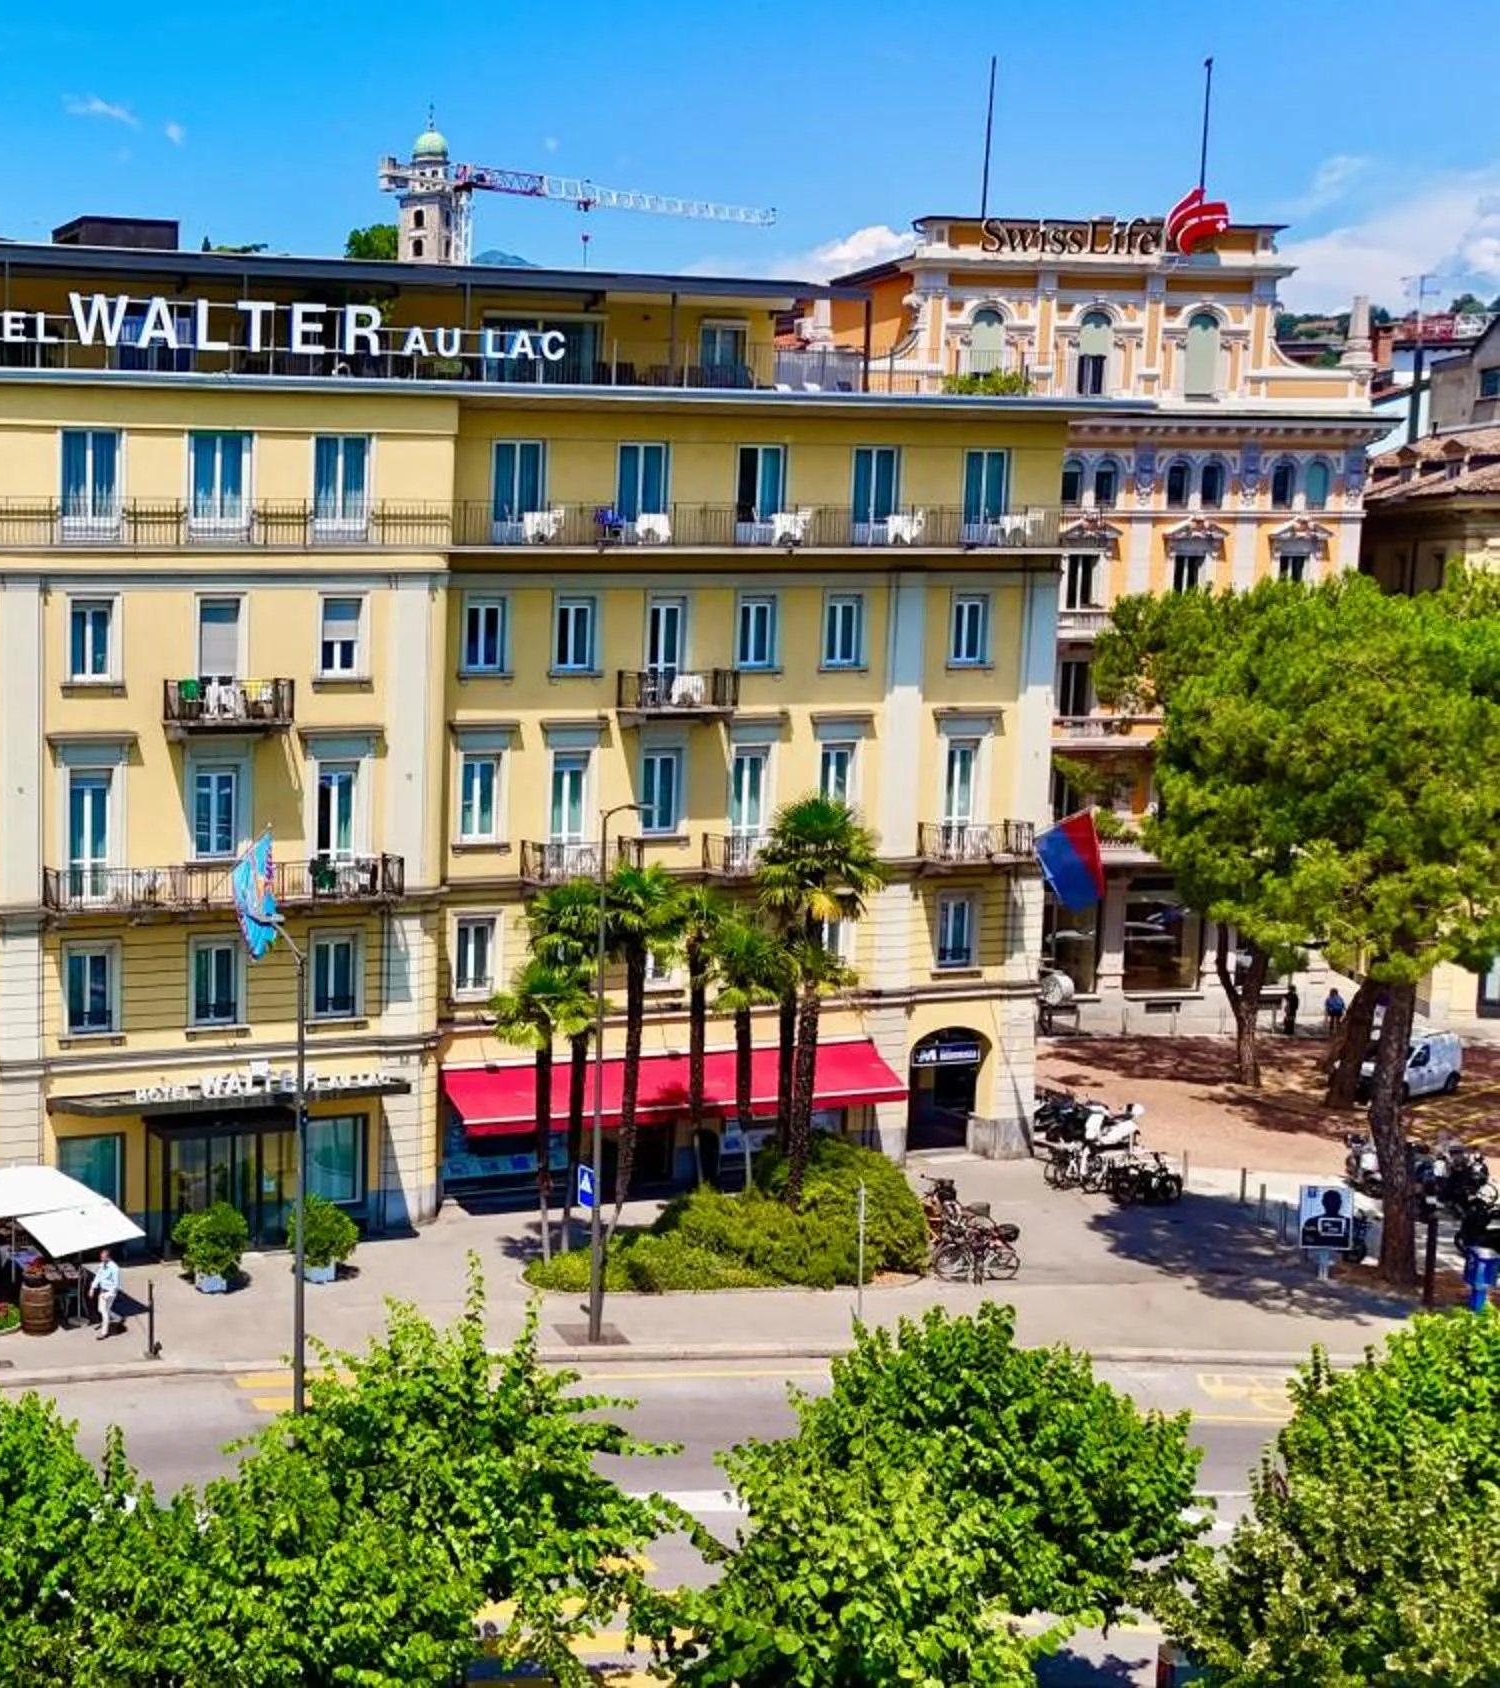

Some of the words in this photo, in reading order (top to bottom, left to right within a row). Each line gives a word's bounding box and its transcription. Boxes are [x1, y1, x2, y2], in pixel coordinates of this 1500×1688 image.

[68, 291, 382, 356] WALTER
[402, 326, 461, 357] AU
[479, 328, 566, 361] LAC
[134, 1087, 192, 1103] HOTEL
